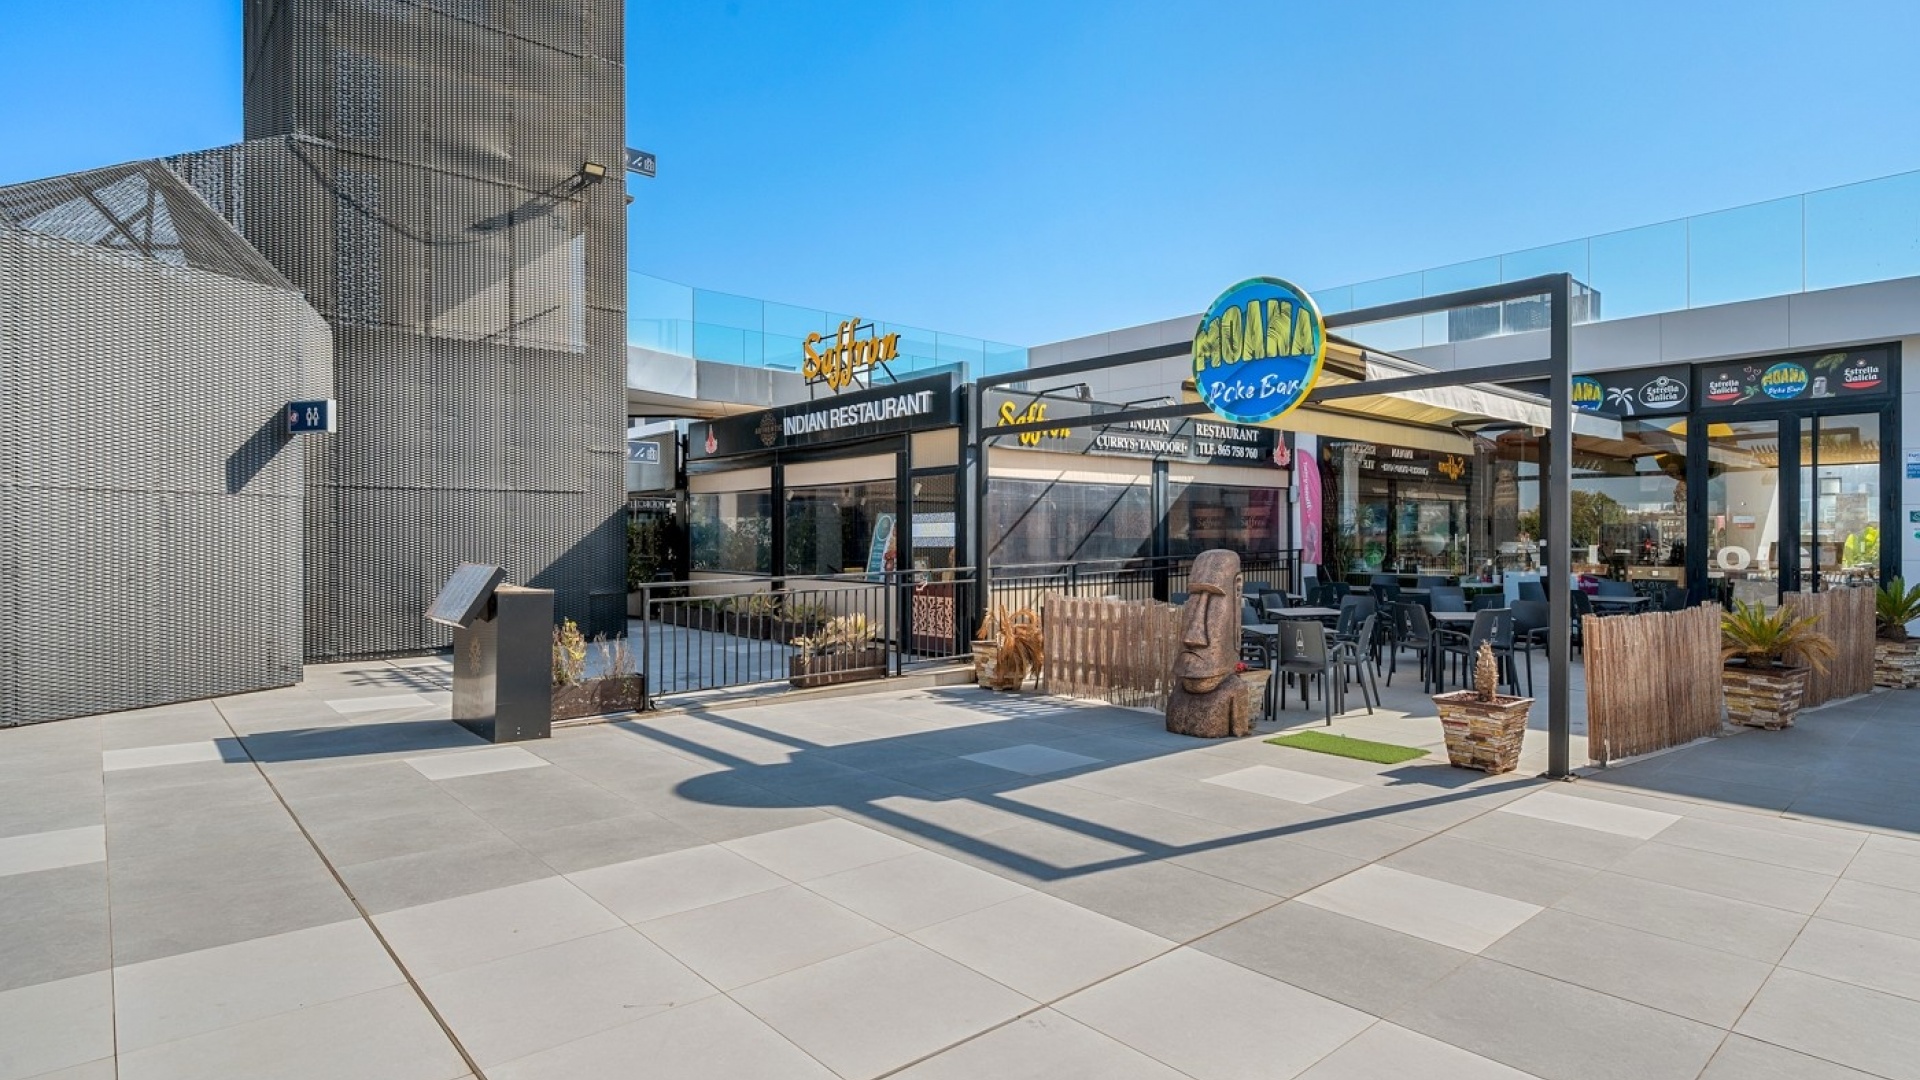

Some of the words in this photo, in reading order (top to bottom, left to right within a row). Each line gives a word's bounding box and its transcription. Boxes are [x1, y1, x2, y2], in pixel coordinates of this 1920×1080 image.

[1196, 299, 1315, 371] MOANA
[803, 317, 897, 391] Saffron
[1762, 367, 1806, 387] MOANA
[1844, 365, 1879, 376] Estrella
[1845, 373, 1878, 382] Galicia
[1259, 374, 1300, 398] Bar
[1572, 382, 1601, 402] ANA
[1646, 385, 1680, 395] Estrella
[1710, 379, 1740, 388] Estrella
[1710, 386, 1739, 395] Galicia
[1647, 392, 1678, 402] Galicia
[783, 411, 828, 436] INDIAN
[830, 390, 934, 428] RESTAURANT
[1130, 419, 1169, 432] INDIAN
[1195, 423, 1259, 442] RESTAURANT
[1217, 444, 1231, 457] 865
[1232, 446, 1245, 458] 758
[1245, 447, 1259, 459] 760
